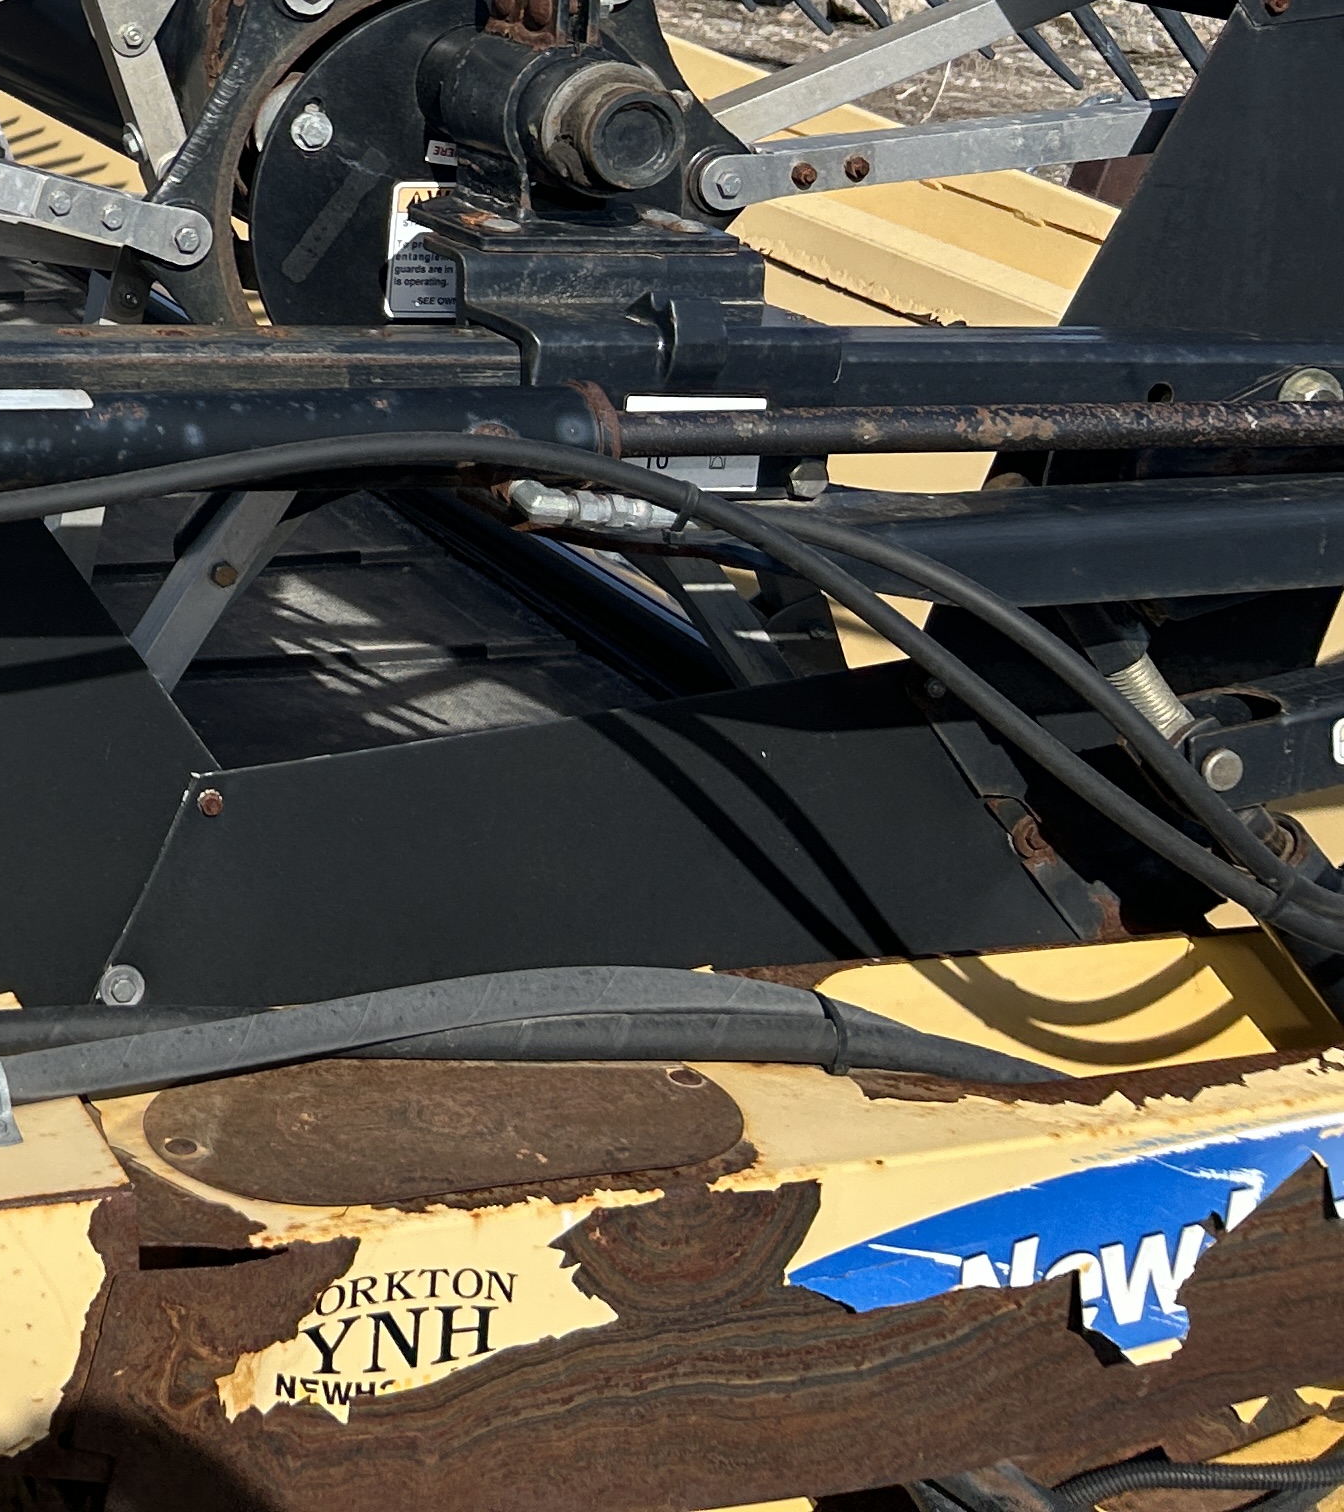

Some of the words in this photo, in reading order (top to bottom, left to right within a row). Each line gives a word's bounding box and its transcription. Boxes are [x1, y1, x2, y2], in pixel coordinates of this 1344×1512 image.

[395, 253, 454, 263] entangle
[394, 265, 427, 275] guards
[428, 266, 443, 274] are
[300, 1305, 499, 1374] YNH
